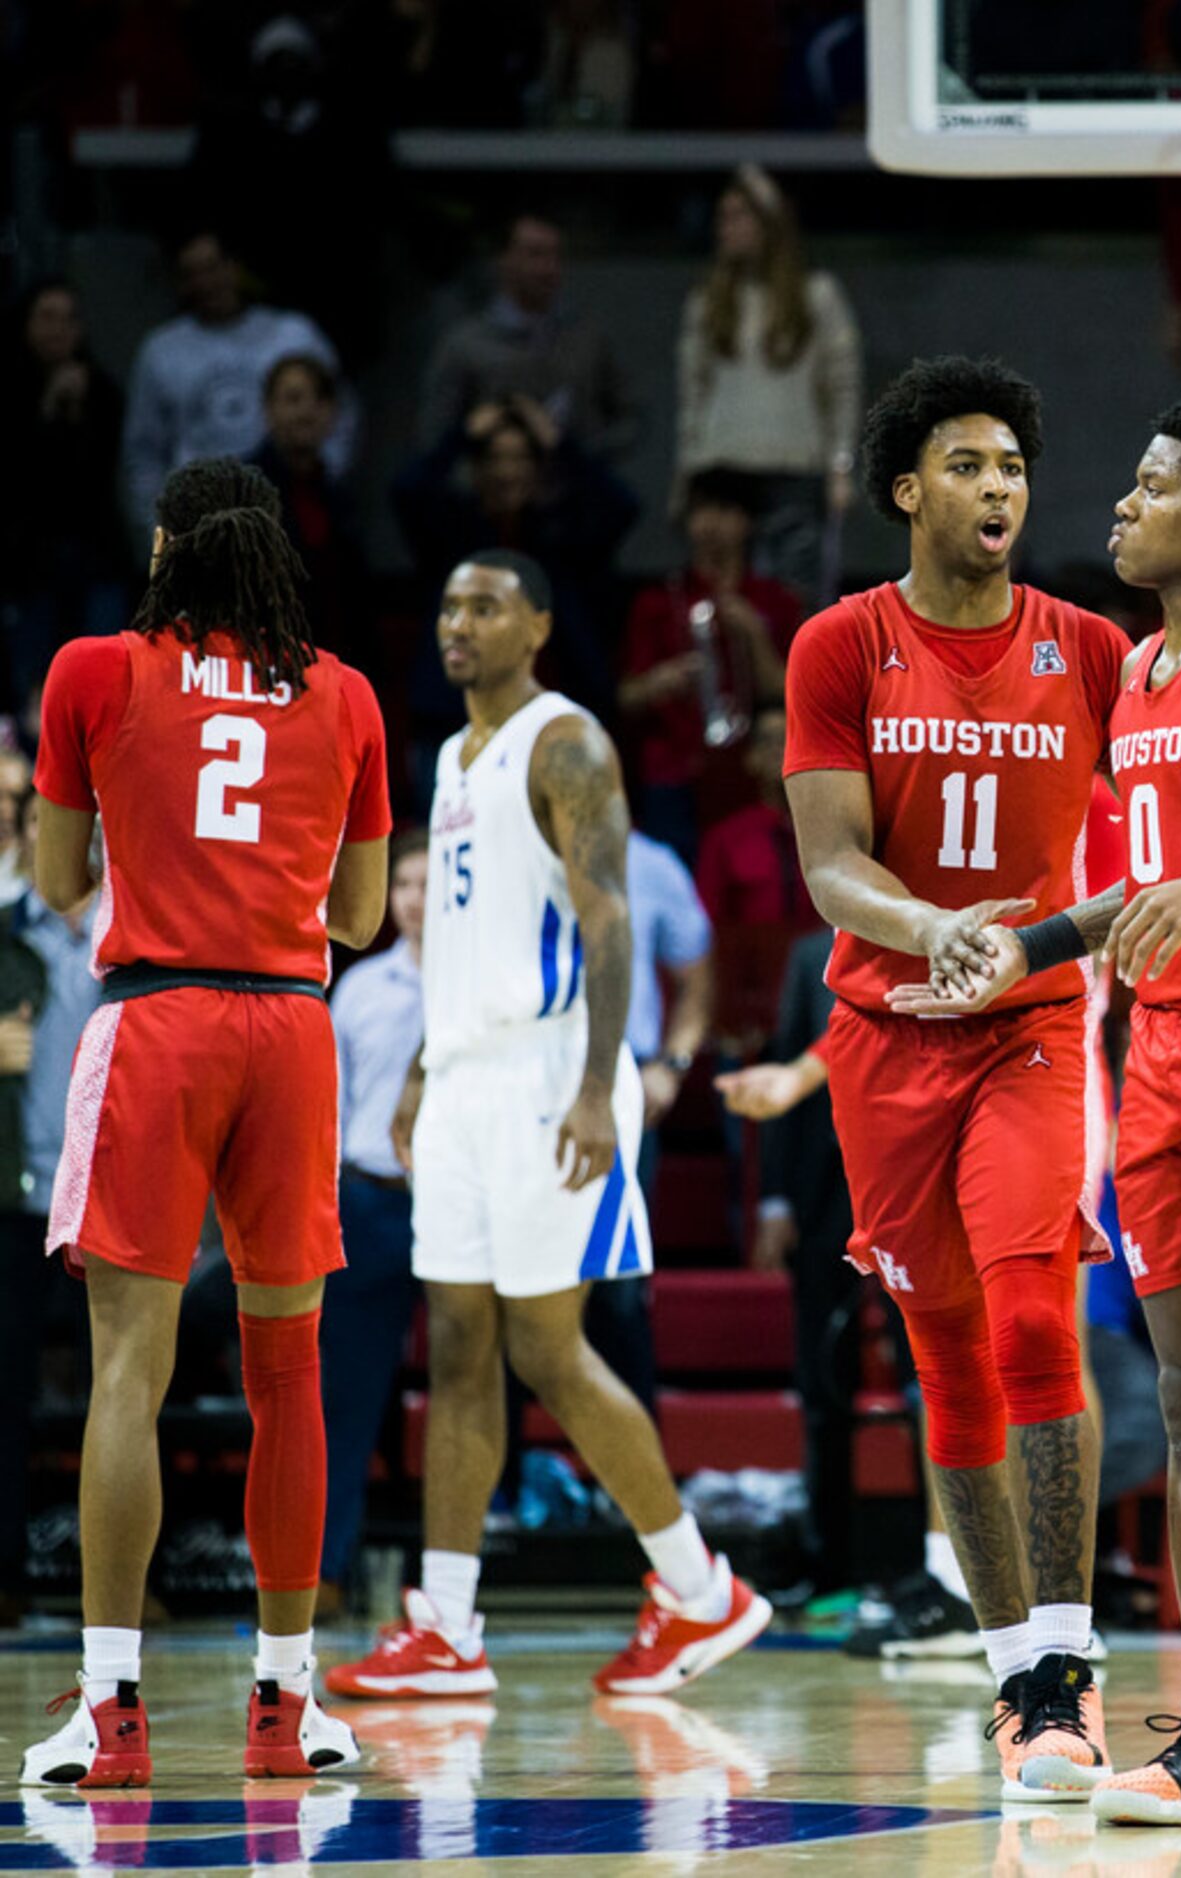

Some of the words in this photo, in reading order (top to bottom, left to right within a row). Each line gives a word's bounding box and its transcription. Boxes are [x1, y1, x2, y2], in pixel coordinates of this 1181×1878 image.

[195, 713, 267, 844] 2
[871, 717, 1067, 760] HOUSTON
[938, 772, 998, 871] 11
[1129, 783, 1164, 885] 0
[443, 842, 473, 912] 15
